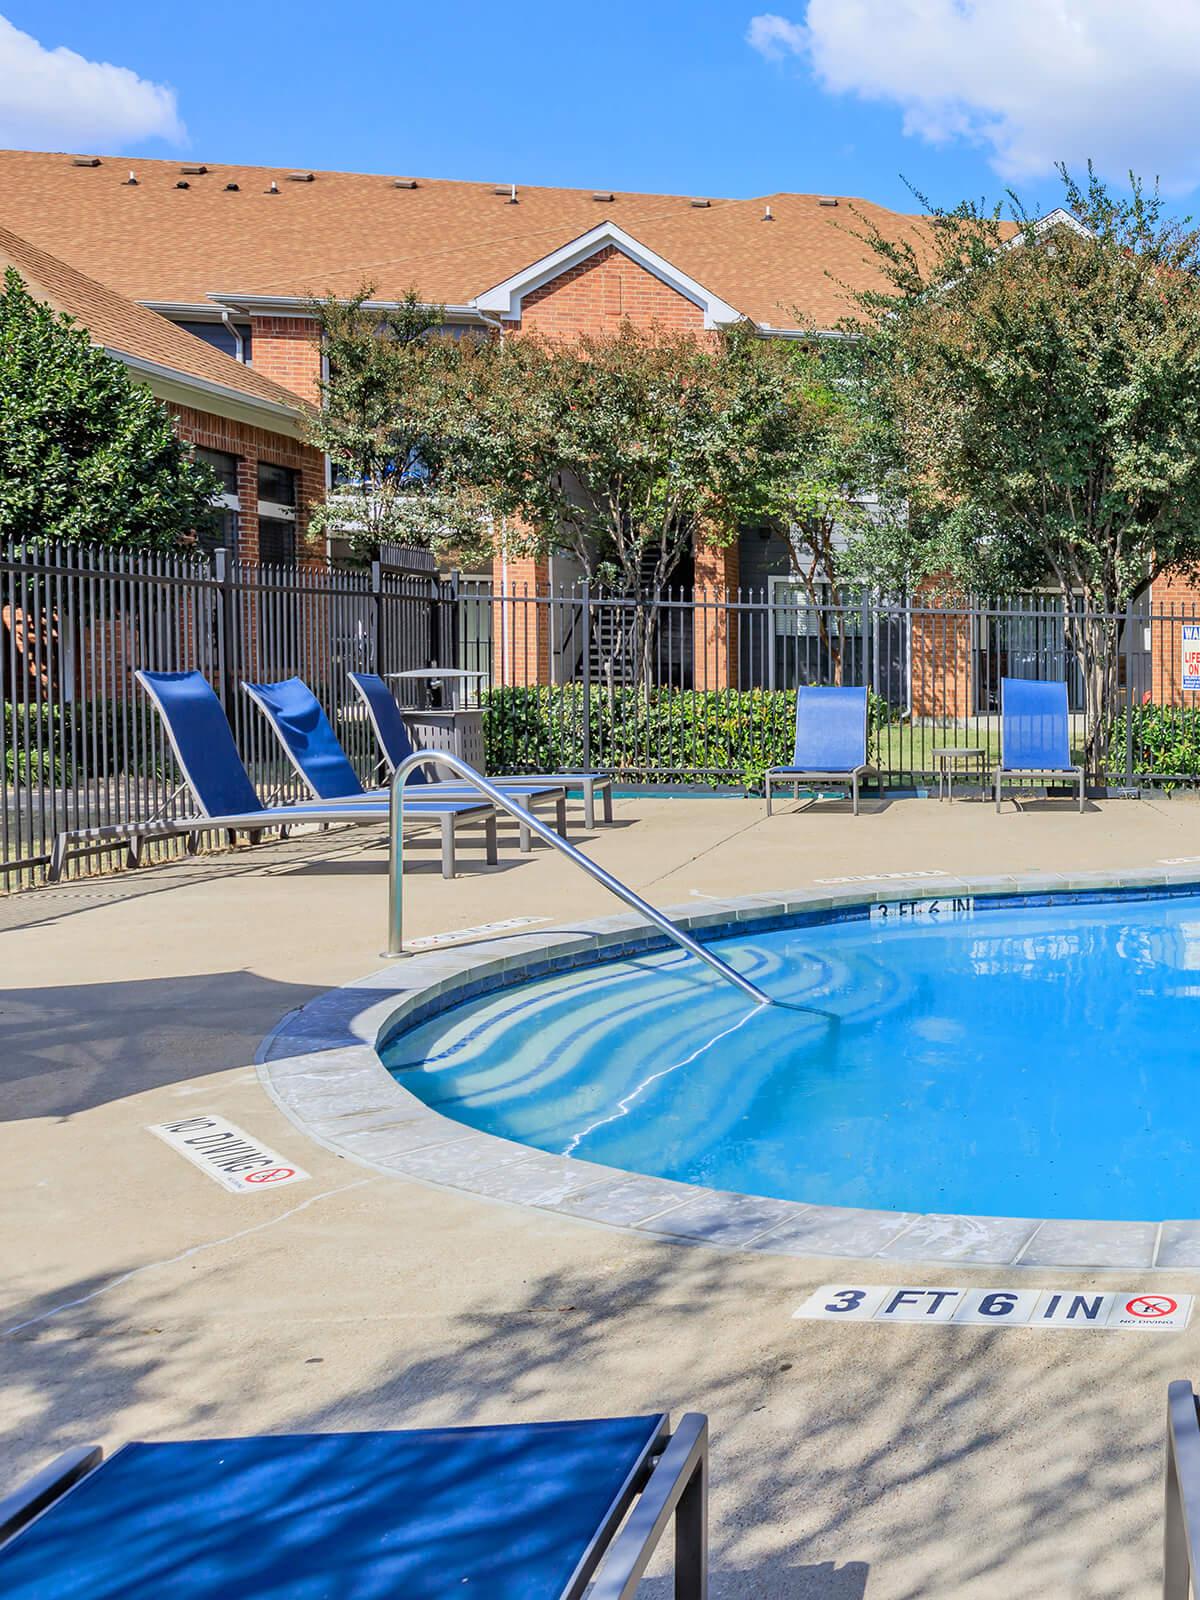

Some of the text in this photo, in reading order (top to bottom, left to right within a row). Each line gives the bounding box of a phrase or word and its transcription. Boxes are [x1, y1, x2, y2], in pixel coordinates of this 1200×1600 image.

[1188, 664, 1199, 675] ON
[899, 901, 918, 916] FT
[952, 898, 970, 912] IN
[160, 1117, 273, 1172] NO DIVING
[824, 1290, 1105, 1320] 3 FT 6 IN
